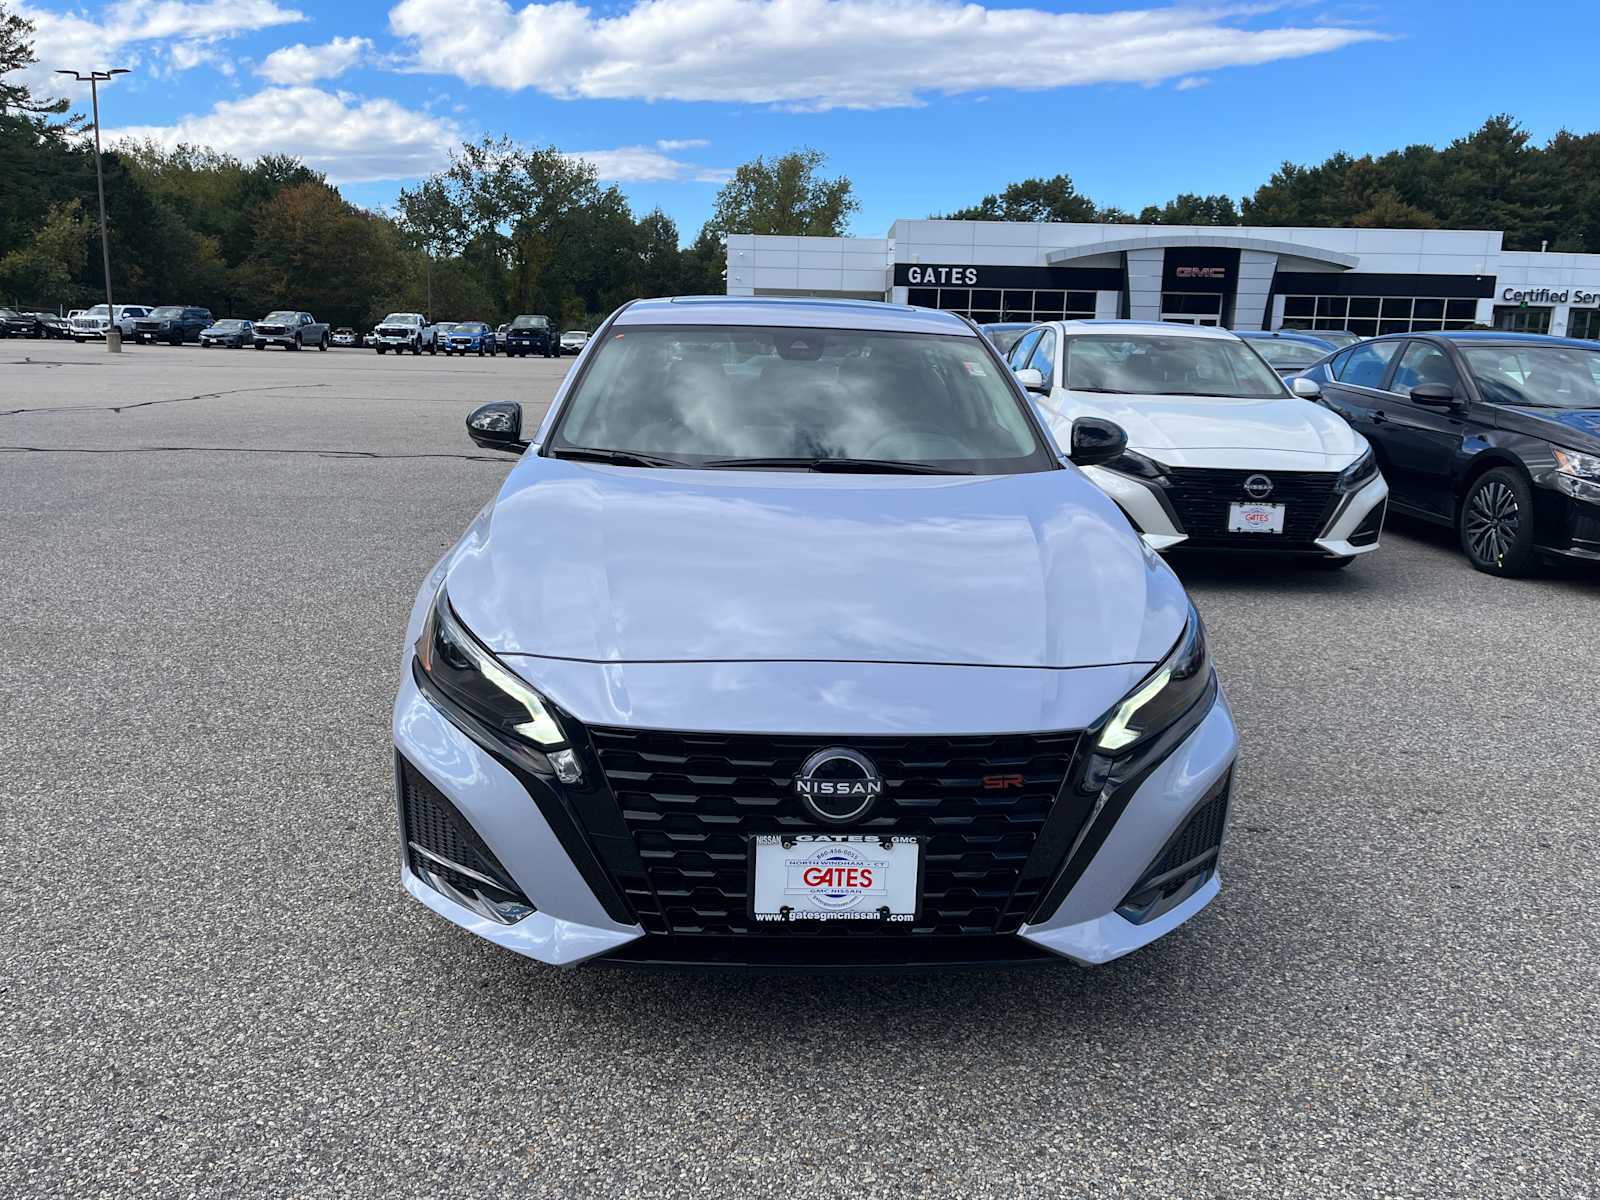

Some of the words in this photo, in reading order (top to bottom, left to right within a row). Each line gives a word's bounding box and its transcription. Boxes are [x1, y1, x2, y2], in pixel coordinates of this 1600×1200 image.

[908, 267, 977, 284] GATES
[1176, 266, 1225, 278] GMC
[1503, 288, 1569, 303] Certified
[1573, 290, 1600, 304] Ser
[1245, 513, 1270, 522] GATES
[796, 780, 881, 794] NISSAN
[983, 774, 1024, 789] SR
[756, 835, 782, 843] NISSAN
[891, 836, 918, 844] GMC
[803, 867, 873, 888] GATES
[788, 911, 881, 921] gatesgmcnissan
[886, 914, 914, 922] .com
